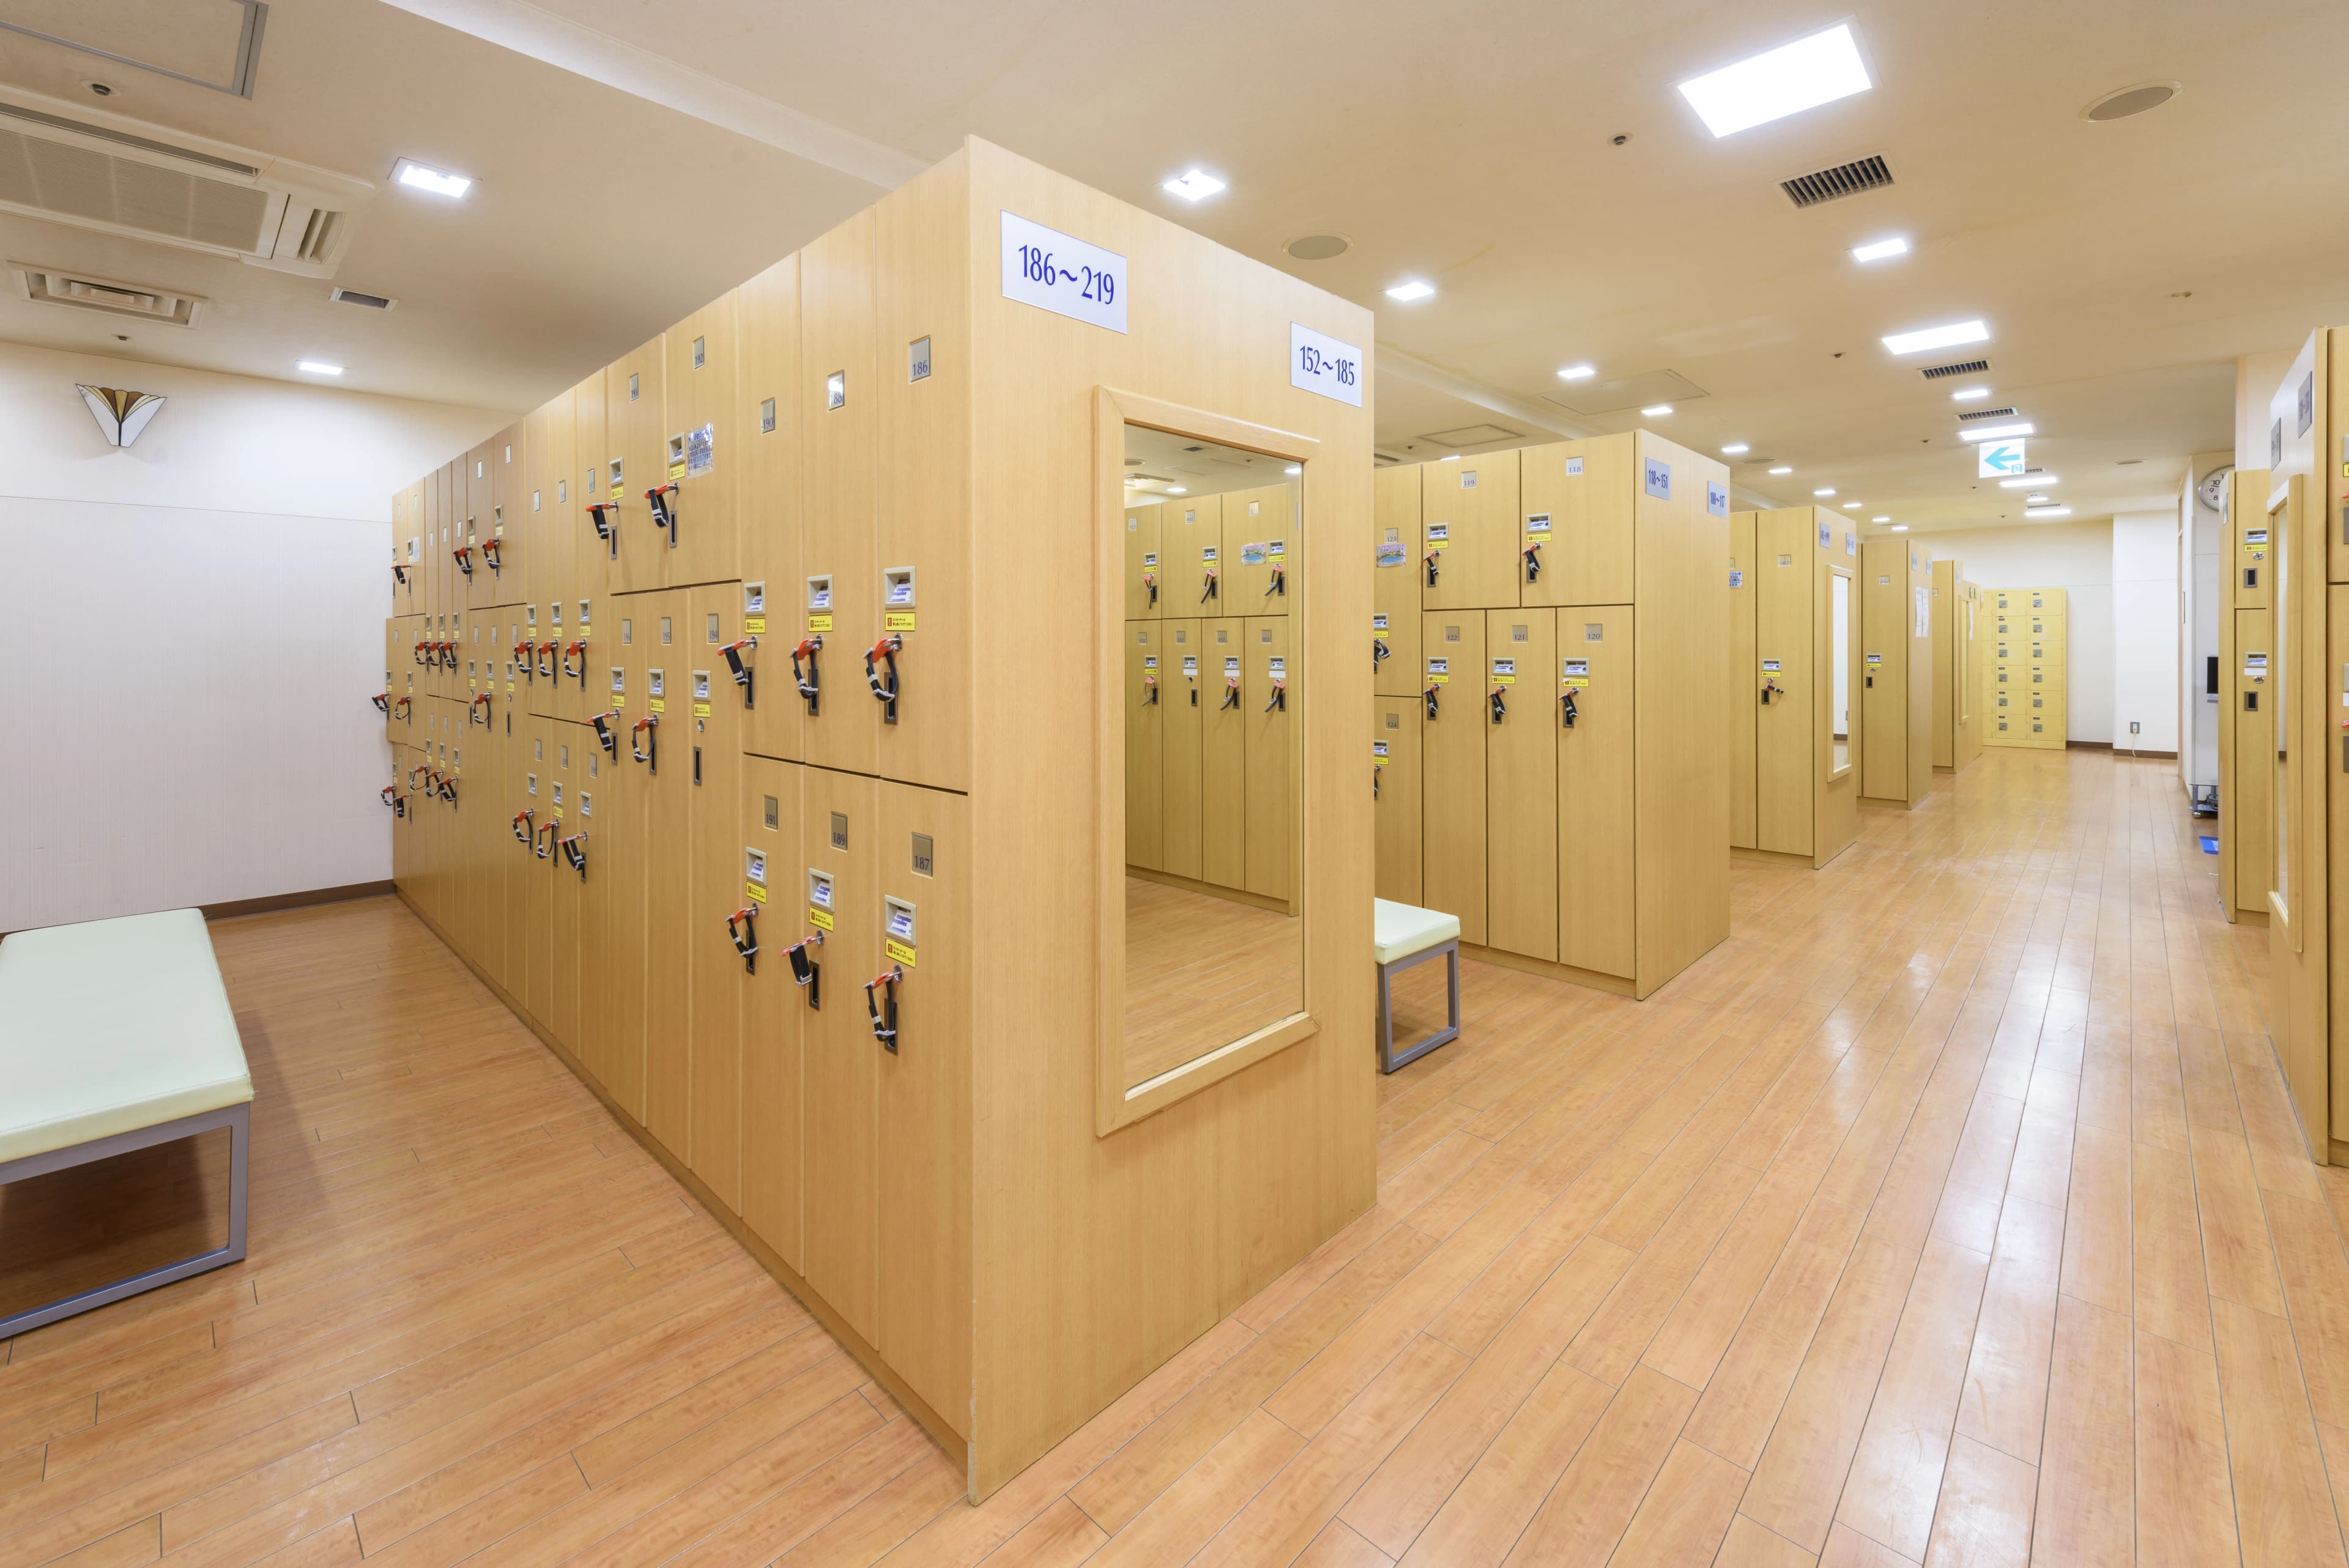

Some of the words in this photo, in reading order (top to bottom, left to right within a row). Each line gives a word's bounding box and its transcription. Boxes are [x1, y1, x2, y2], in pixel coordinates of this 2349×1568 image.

[1018, 243, 1115, 306] 186～219
[913, 359, 928, 377] 186
[1299, 345, 1356, 387] 152～185
[763, 417, 773, 429] 190
[709, 630, 718, 640] 194
[766, 813, 776, 826] 191
[833, 831, 845, 846] 189
[915, 855, 930, 871] 187
